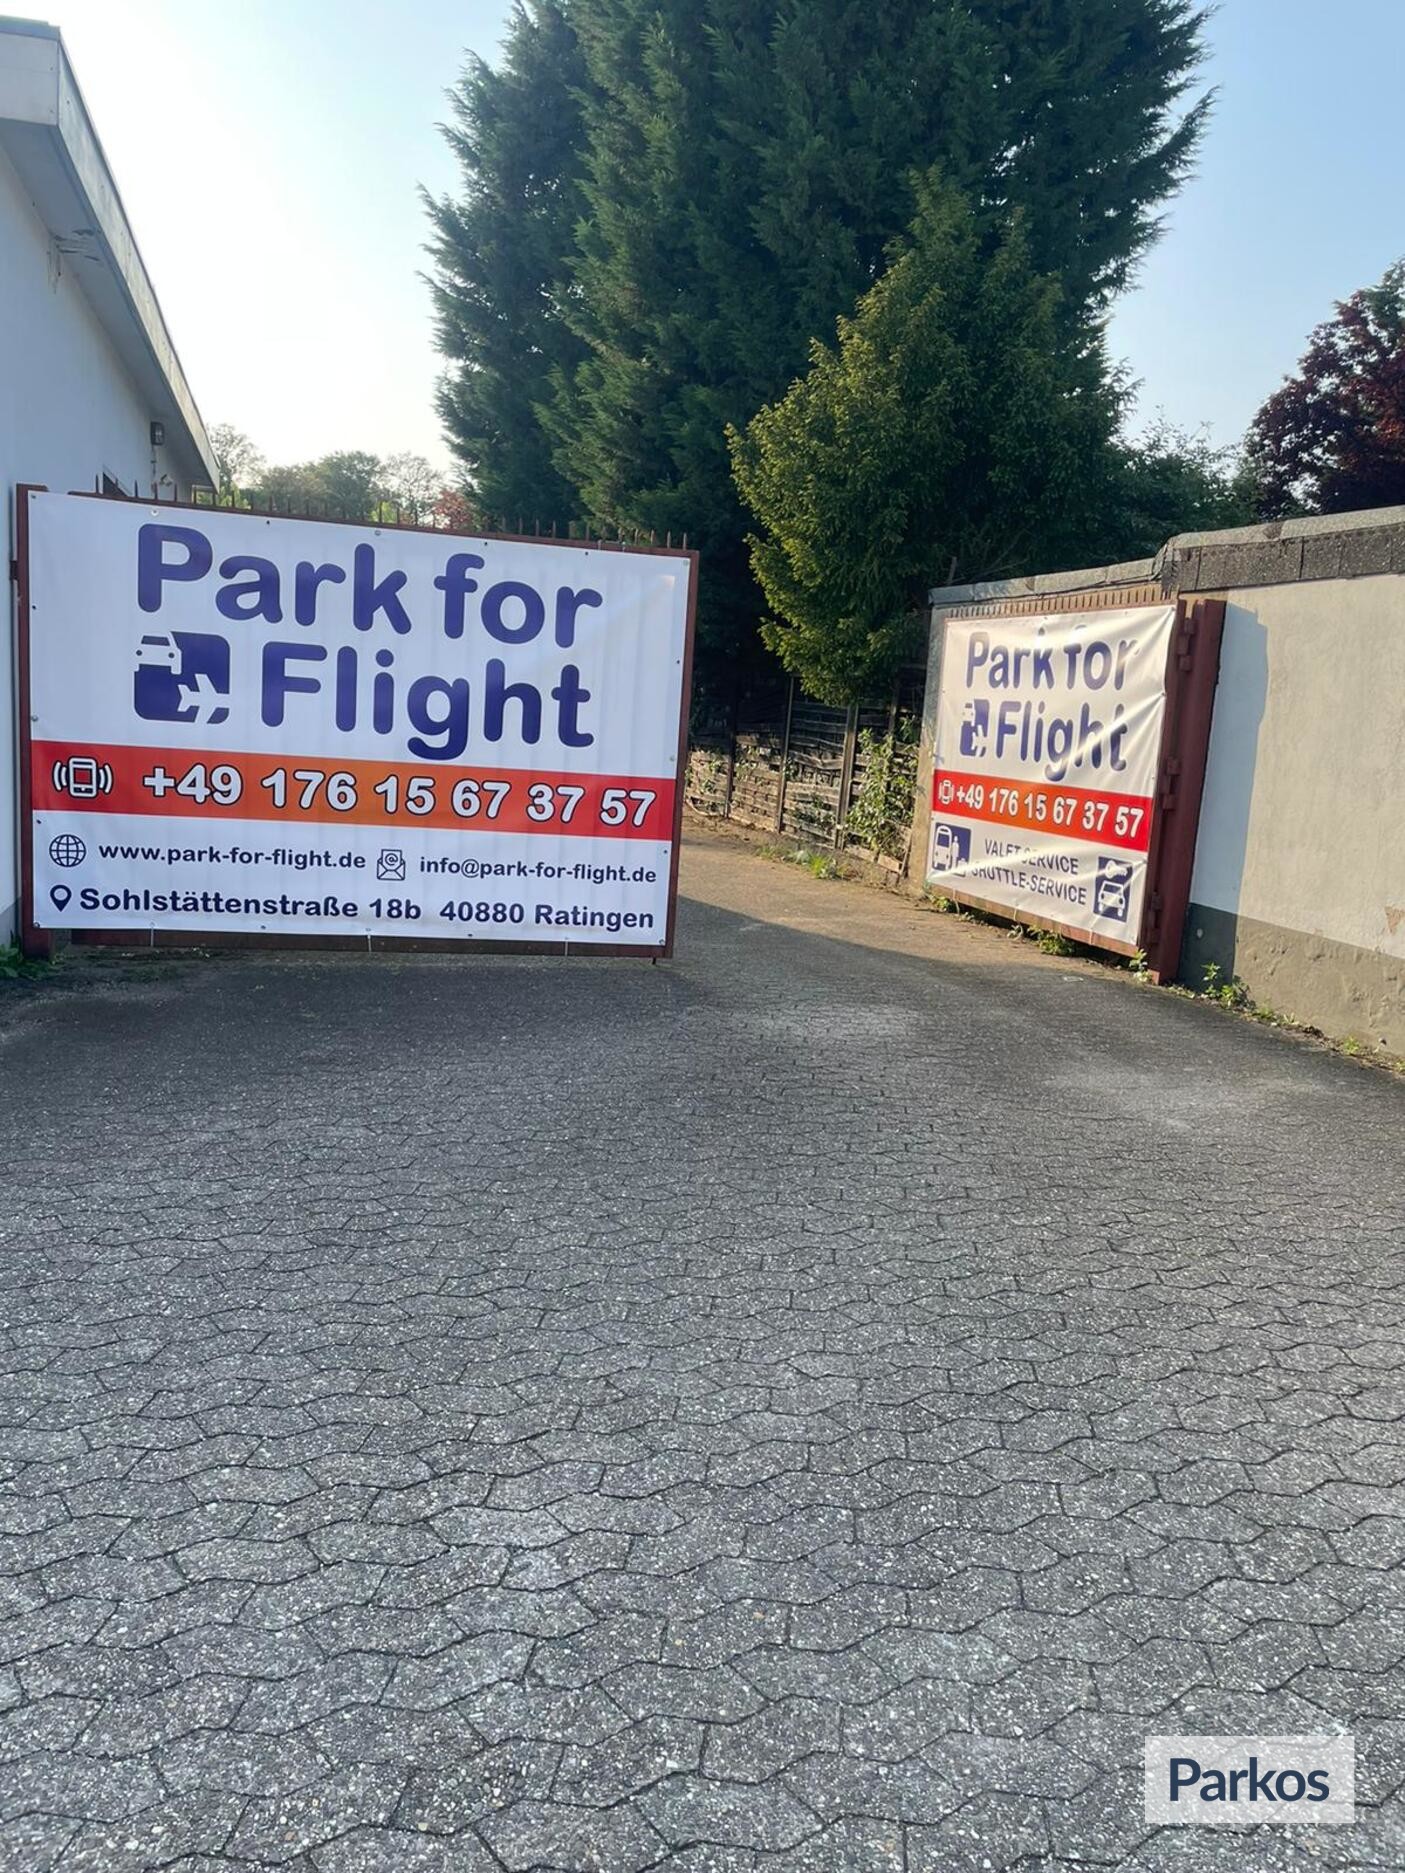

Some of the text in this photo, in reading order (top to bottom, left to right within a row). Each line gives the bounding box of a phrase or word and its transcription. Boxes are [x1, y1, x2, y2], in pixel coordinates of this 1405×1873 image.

[137, 523, 604, 648] Park for
[966, 625, 1140, 691] Park for
[261, 641, 595, 760] Flight
[996, 700, 1128, 782] Flight
[142, 764, 657, 827] +49 176 15 67 37 57
[956, 784, 1145, 838] +49 176 15 67 37 57
[98, 845, 366, 870] www.park-for-flight.de
[419, 856, 657, 884] info@park-for-flight.de
[79, 887, 654, 931] Sohlstättenstraße 18b 40880 Ratingen
